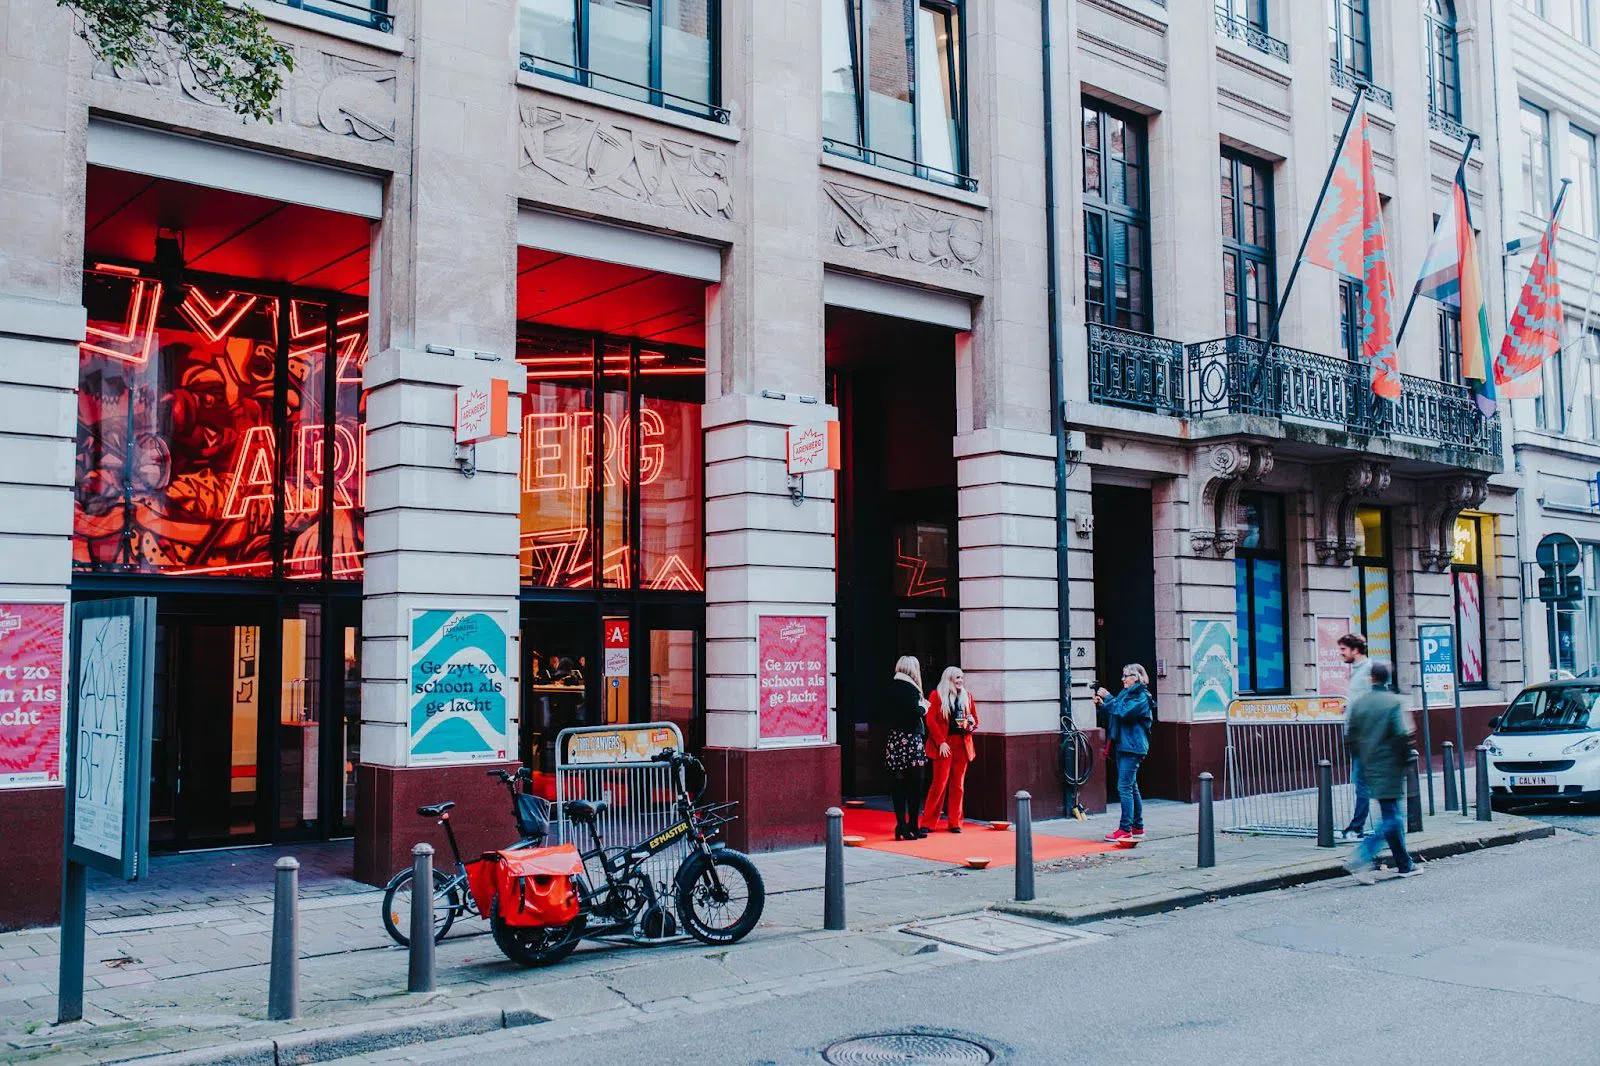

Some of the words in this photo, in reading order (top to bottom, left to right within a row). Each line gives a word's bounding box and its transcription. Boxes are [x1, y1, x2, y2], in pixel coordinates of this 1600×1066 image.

[222, 422, 367, 518] AR
[611, 627, 624, 643] A
[1423, 638, 1438, 660] P
[23, 666, 49, 679] zo
[421, 661, 442, 674] Ge
[447, 662, 475, 678] zyt
[479, 663, 497, 674] zo
[765, 659, 781, 671] Ge
[784, 660, 804, 673] zyt
[807, 660, 821, 670] zo
[1425, 663, 1451, 673] AN091
[415, 680, 474, 694] schoon
[479, 679, 502, 693] als
[762, 675, 805, 688] schoon
[807, 674, 825, 687] als
[21, 684, 57, 703] als
[769, 694, 784, 707] ge
[787, 690, 817, 702] lacht
[426, 702, 445, 717] ge
[449, 699, 492, 712] lacht
